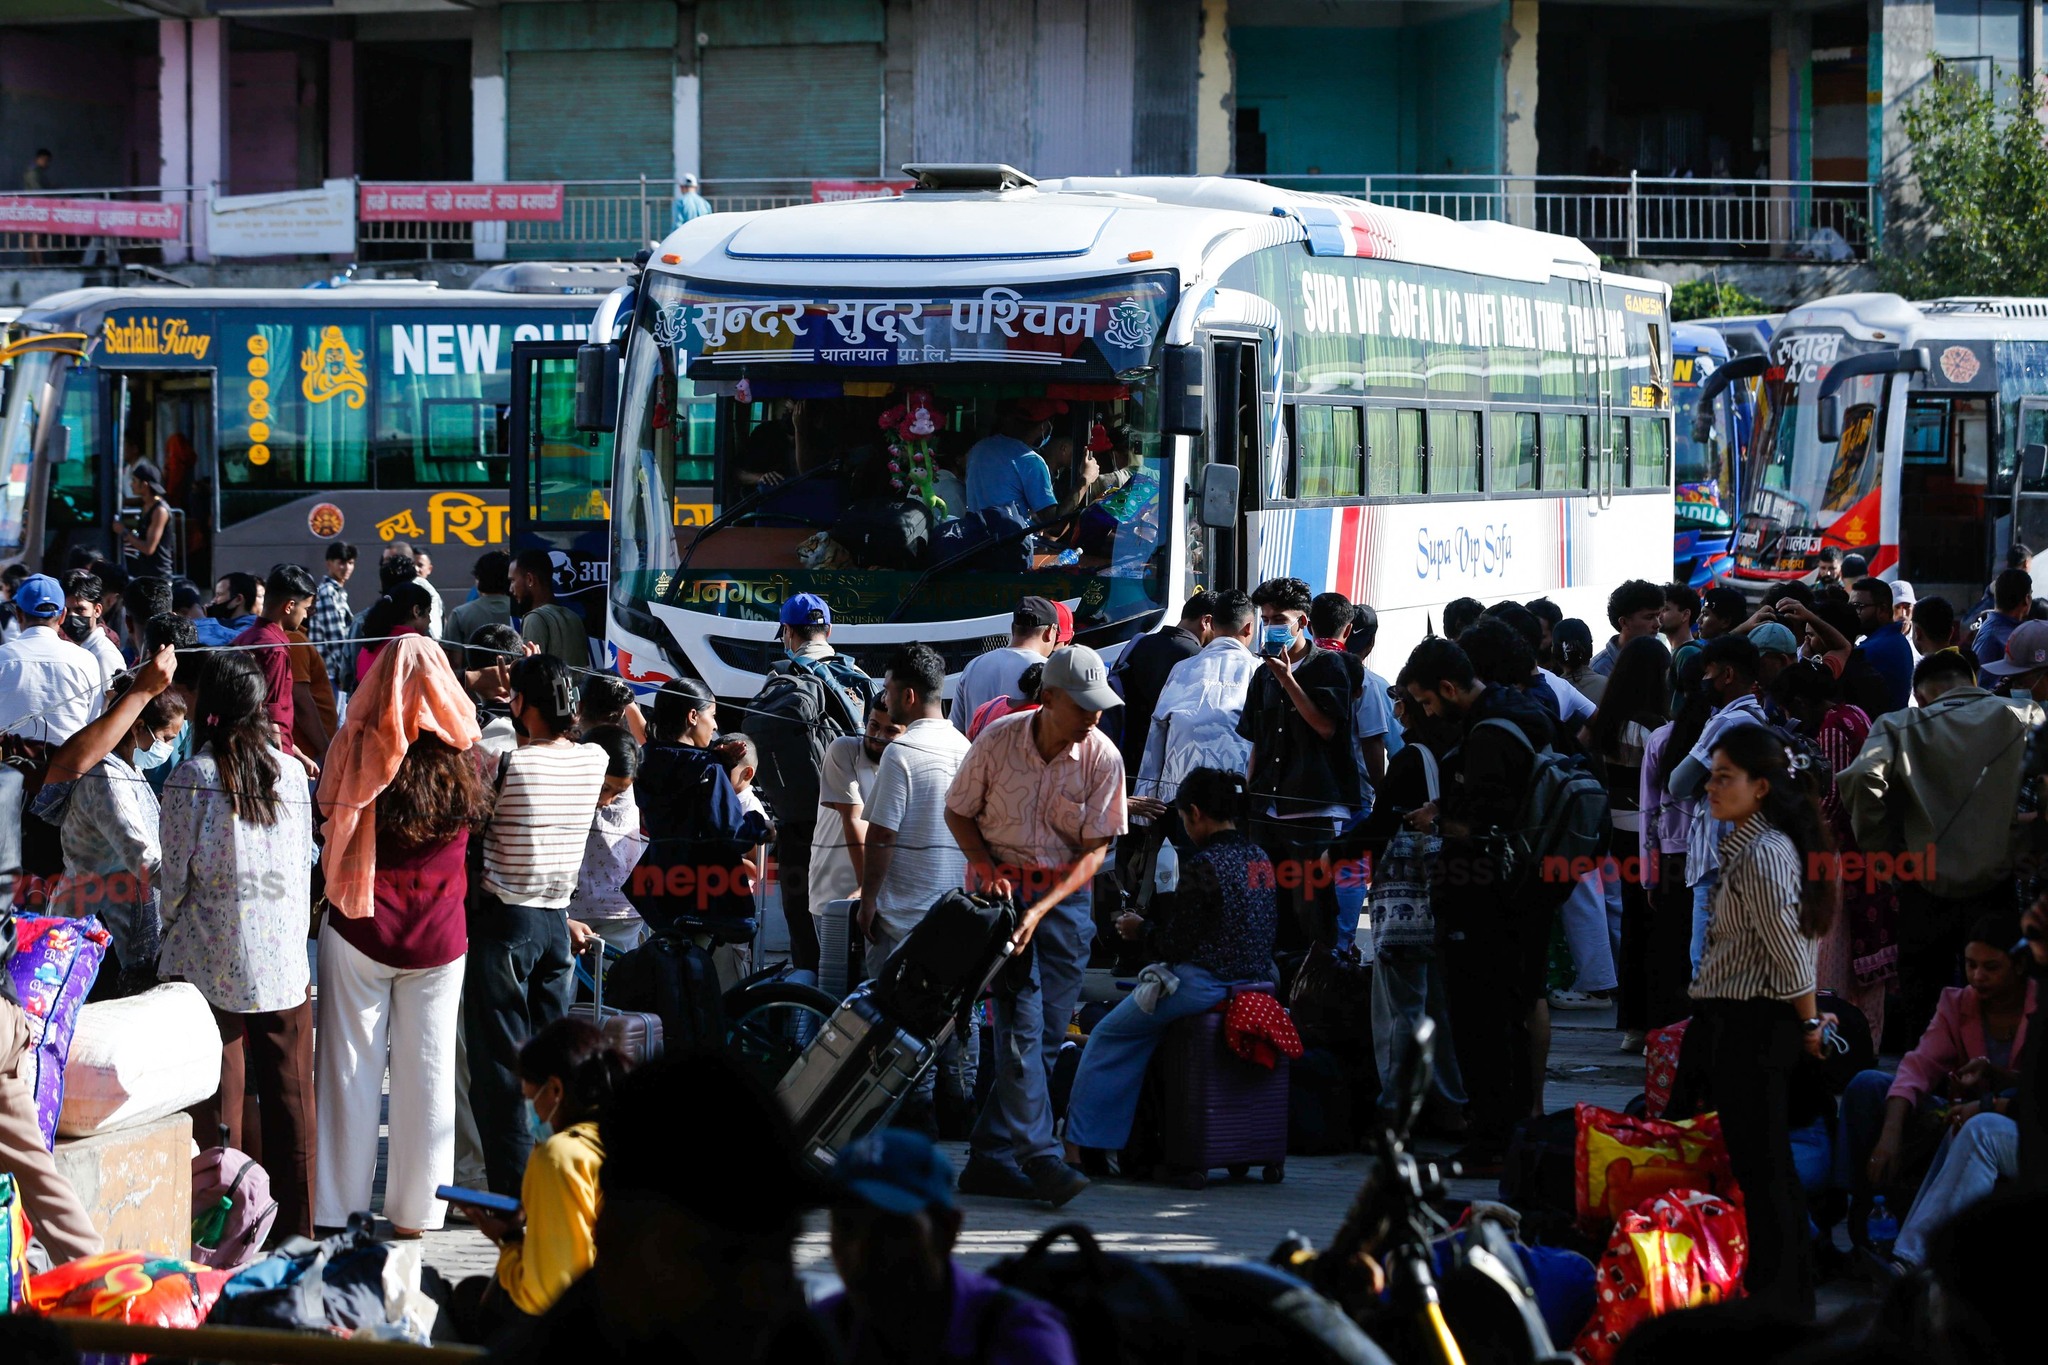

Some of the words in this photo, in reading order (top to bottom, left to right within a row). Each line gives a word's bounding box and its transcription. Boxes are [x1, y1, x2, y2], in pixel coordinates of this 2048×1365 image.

[692, 299, 814, 347] सुन्दर
[827, 299, 933, 344] सुदूर
[951, 286, 1101, 338] पश्चिम
[1302, 270, 1351, 333] SUPA
[1353, 276, 1383, 335] VIP
[1388, 279, 1430, 341] SOFA
[1432, 288, 1463, 346] A/C
[1464, 292, 1498, 347] WIFI
[1501, 295, 1536, 349] REAL
[1535, 299, 1566, 352] TIME
[1625, 294, 1663, 316] GANESH
[105, 317, 159, 355] Sarlahi
[159, 318, 211, 360] King
[392, 324, 500, 375] NEW
[820, 348, 889, 362] यातायात
[1785, 363, 1818, 383] A/C
[1631, 385, 1669, 409] SLEER
[375, 508, 424, 542] न्यू
[427, 491, 511, 547] शि
[1416, 527, 1452, 582] Supa
[1455, 526, 1481, 578] Vip
[1483, 523, 1512, 578] Sofa
